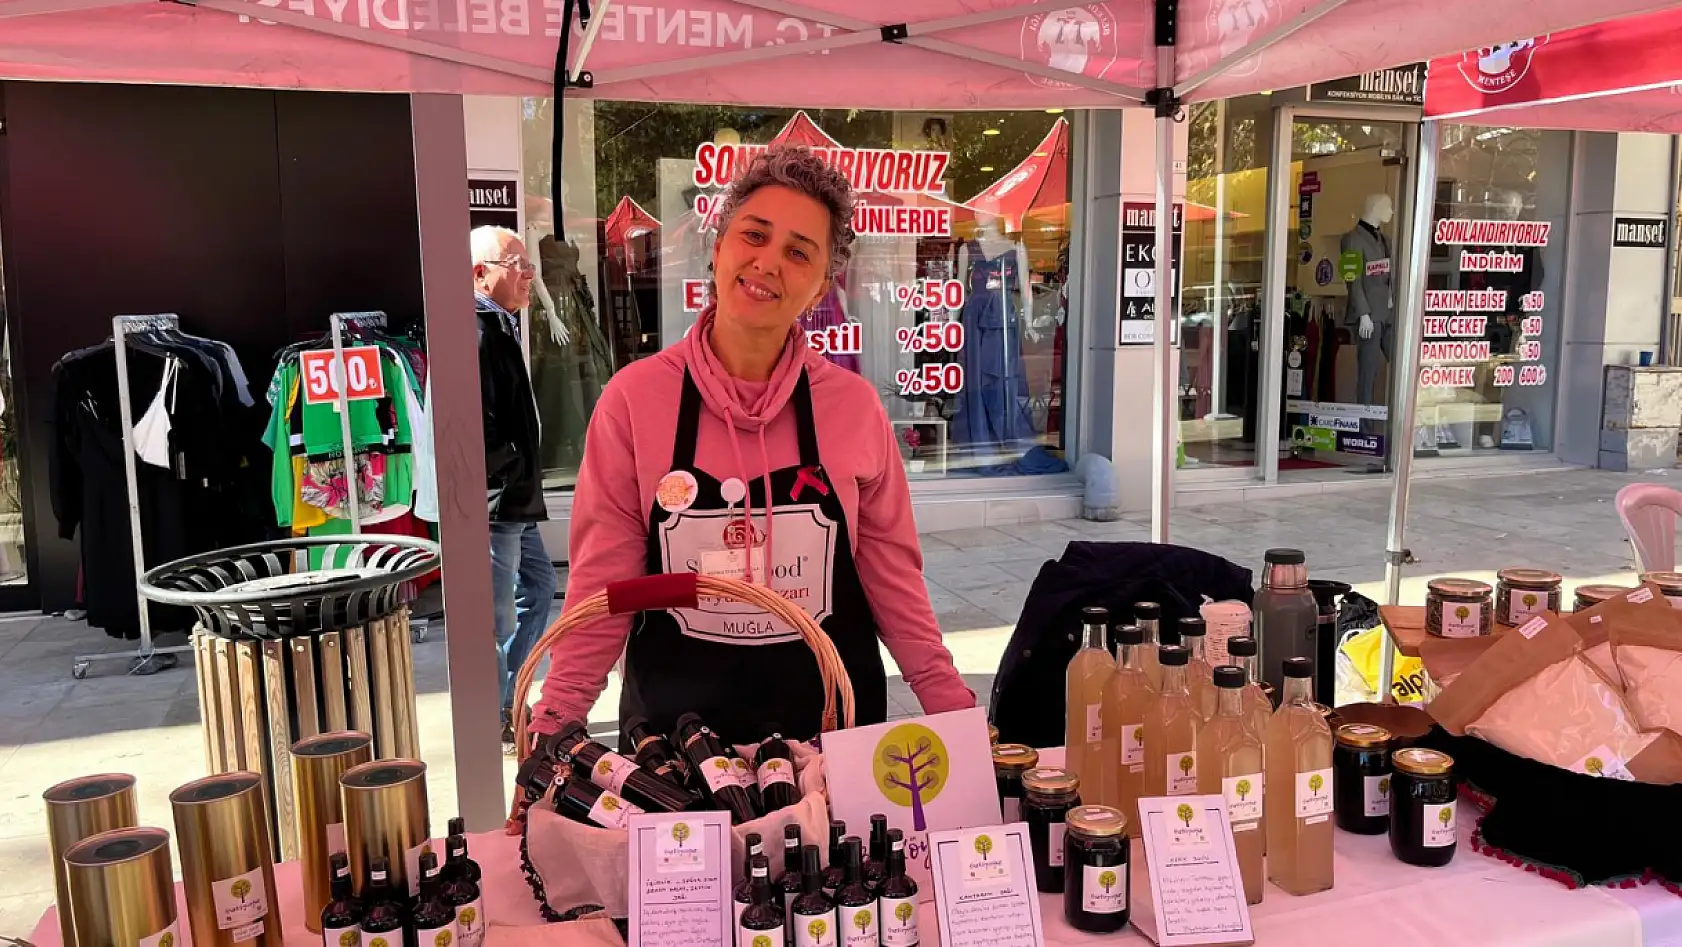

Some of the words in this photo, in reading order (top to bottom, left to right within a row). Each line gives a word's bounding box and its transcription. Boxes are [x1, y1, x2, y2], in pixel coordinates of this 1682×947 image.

[468, 185, 510, 207] anşet
[1436, 219, 1550, 246] SONLANDIRIYORUZ
[1460, 250, 1523, 271] İNDİRİM
[897, 280, 963, 310] %50
[1425, 291, 1465, 310] TAKIM
[1467, 287, 1506, 310] ELBİSE
[897, 322, 963, 352] %50
[1424, 317, 1448, 336] TEK
[1449, 317, 1487, 337] CEKET
[810, 324, 862, 354] stil
[1421, 342, 1490, 361] PANTOLON
[897, 364, 963, 394] %50
[1420, 364, 1475, 387] GÖMLEK
[1342, 437, 1378, 448] WORLD
[723, 620, 775, 634] MUĞLA
